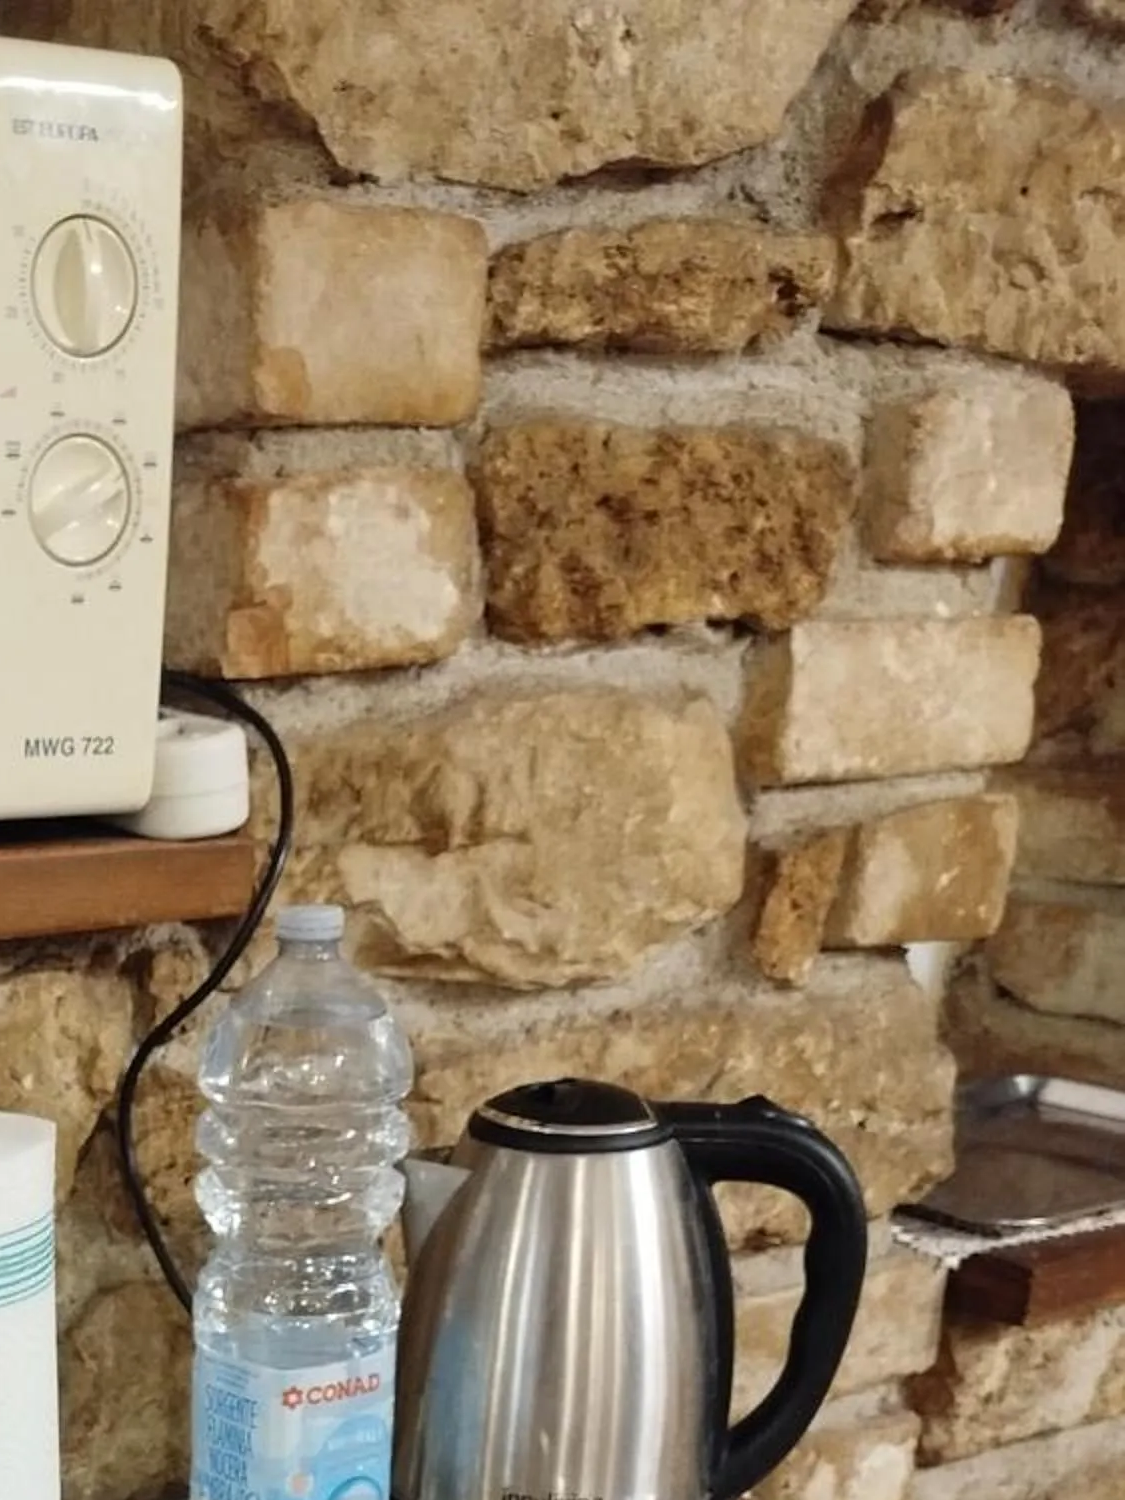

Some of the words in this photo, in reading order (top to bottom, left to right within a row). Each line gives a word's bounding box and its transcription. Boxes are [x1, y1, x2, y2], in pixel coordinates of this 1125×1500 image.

[24, 737, 75, 758] MWG
[81, 736, 115, 756] 722
[307, 1373, 380, 1405] CONAD
